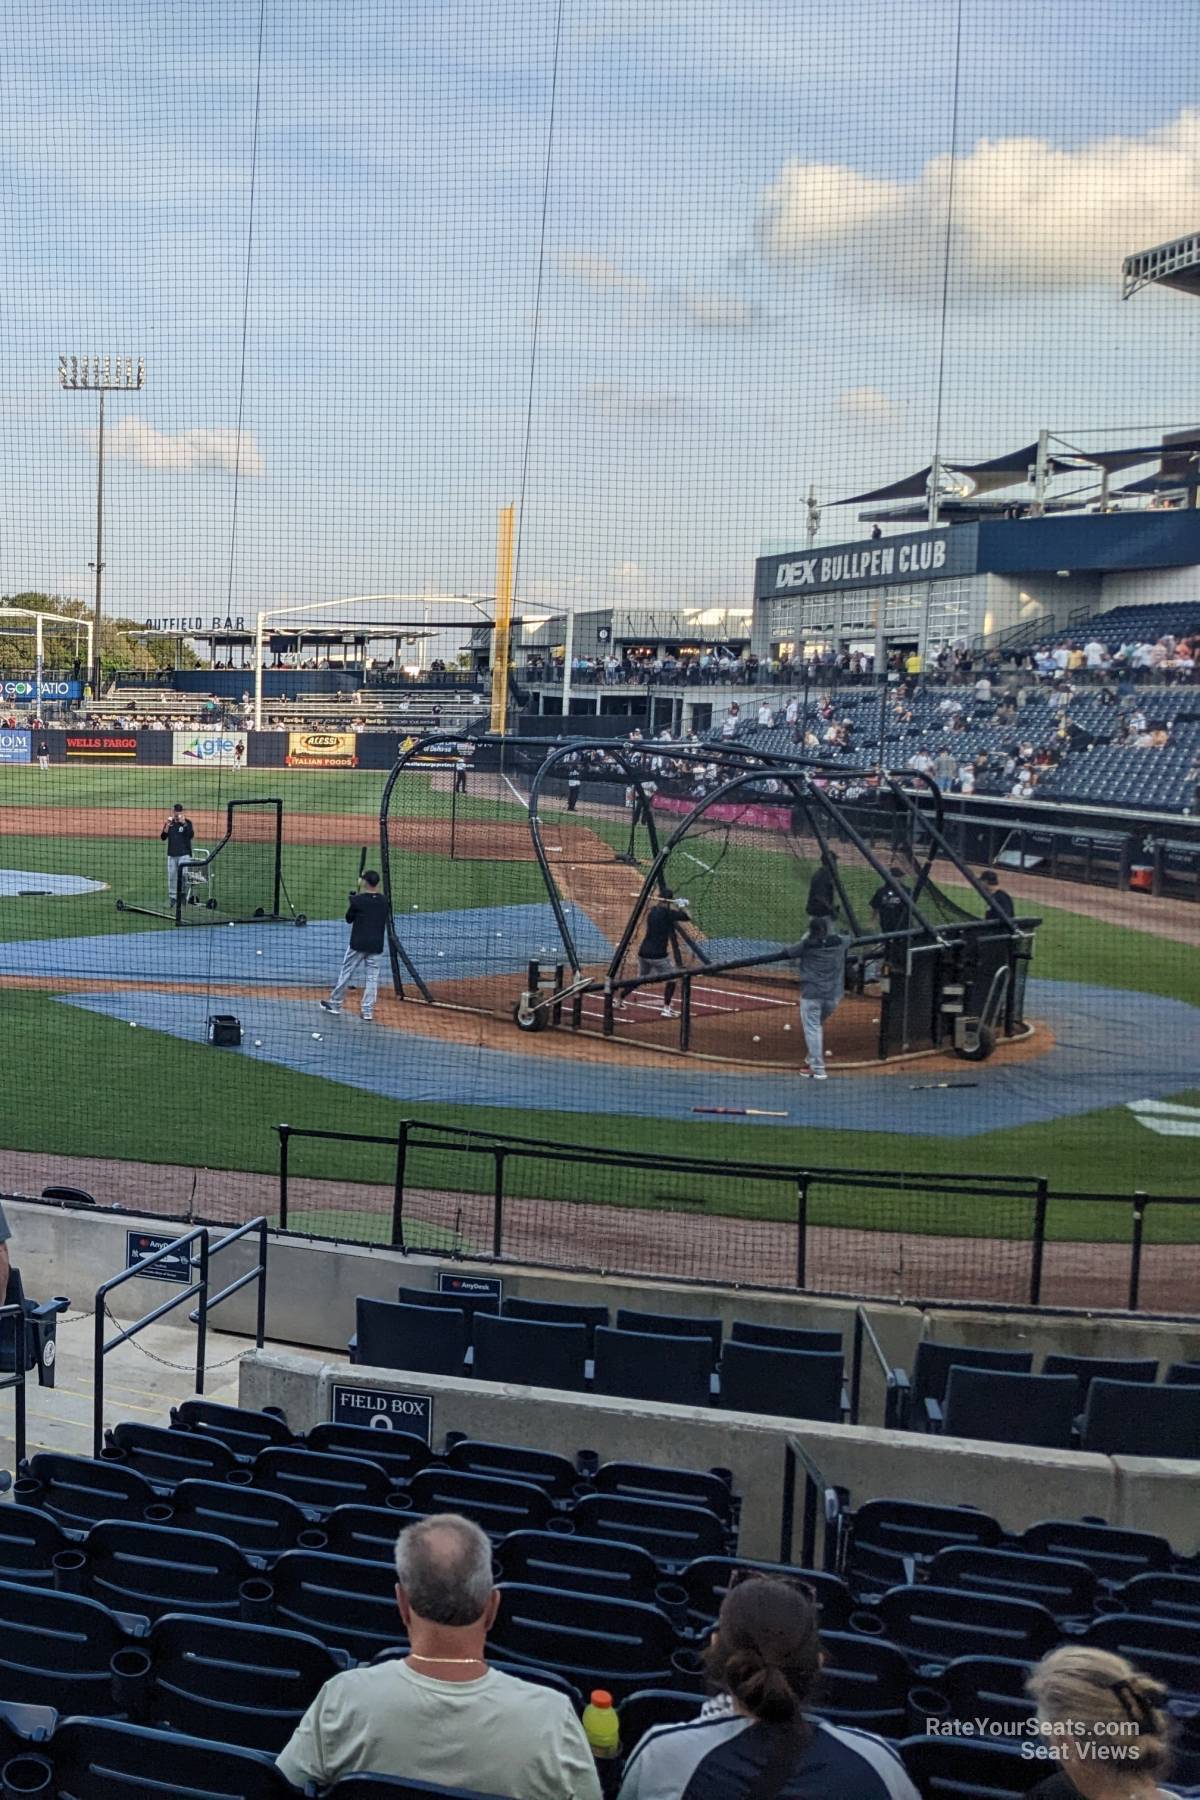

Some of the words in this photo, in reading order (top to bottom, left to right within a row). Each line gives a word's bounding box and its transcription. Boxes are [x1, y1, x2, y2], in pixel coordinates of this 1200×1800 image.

[775, 558, 817, 589] DEX
[820, 548, 894, 582] BULLPEN
[899, 540, 946, 573] CLUB
[145, 617, 202, 631] OUTFIELD
[212, 616, 244, 631] BAR
[5, 682, 28, 694] GO
[67, 738, 101, 748] WELLS
[103, 738, 137, 748] FARGO
[307, 736, 338, 746] ALESSI
[291, 757, 323, 766] ITALIAN
[324, 758, 352, 766] FOODS
[461, 1281, 490, 1290] AnyDesk
[341, 1393, 387, 1411] FIELD
[391, 1400, 425, 1416] BOX
